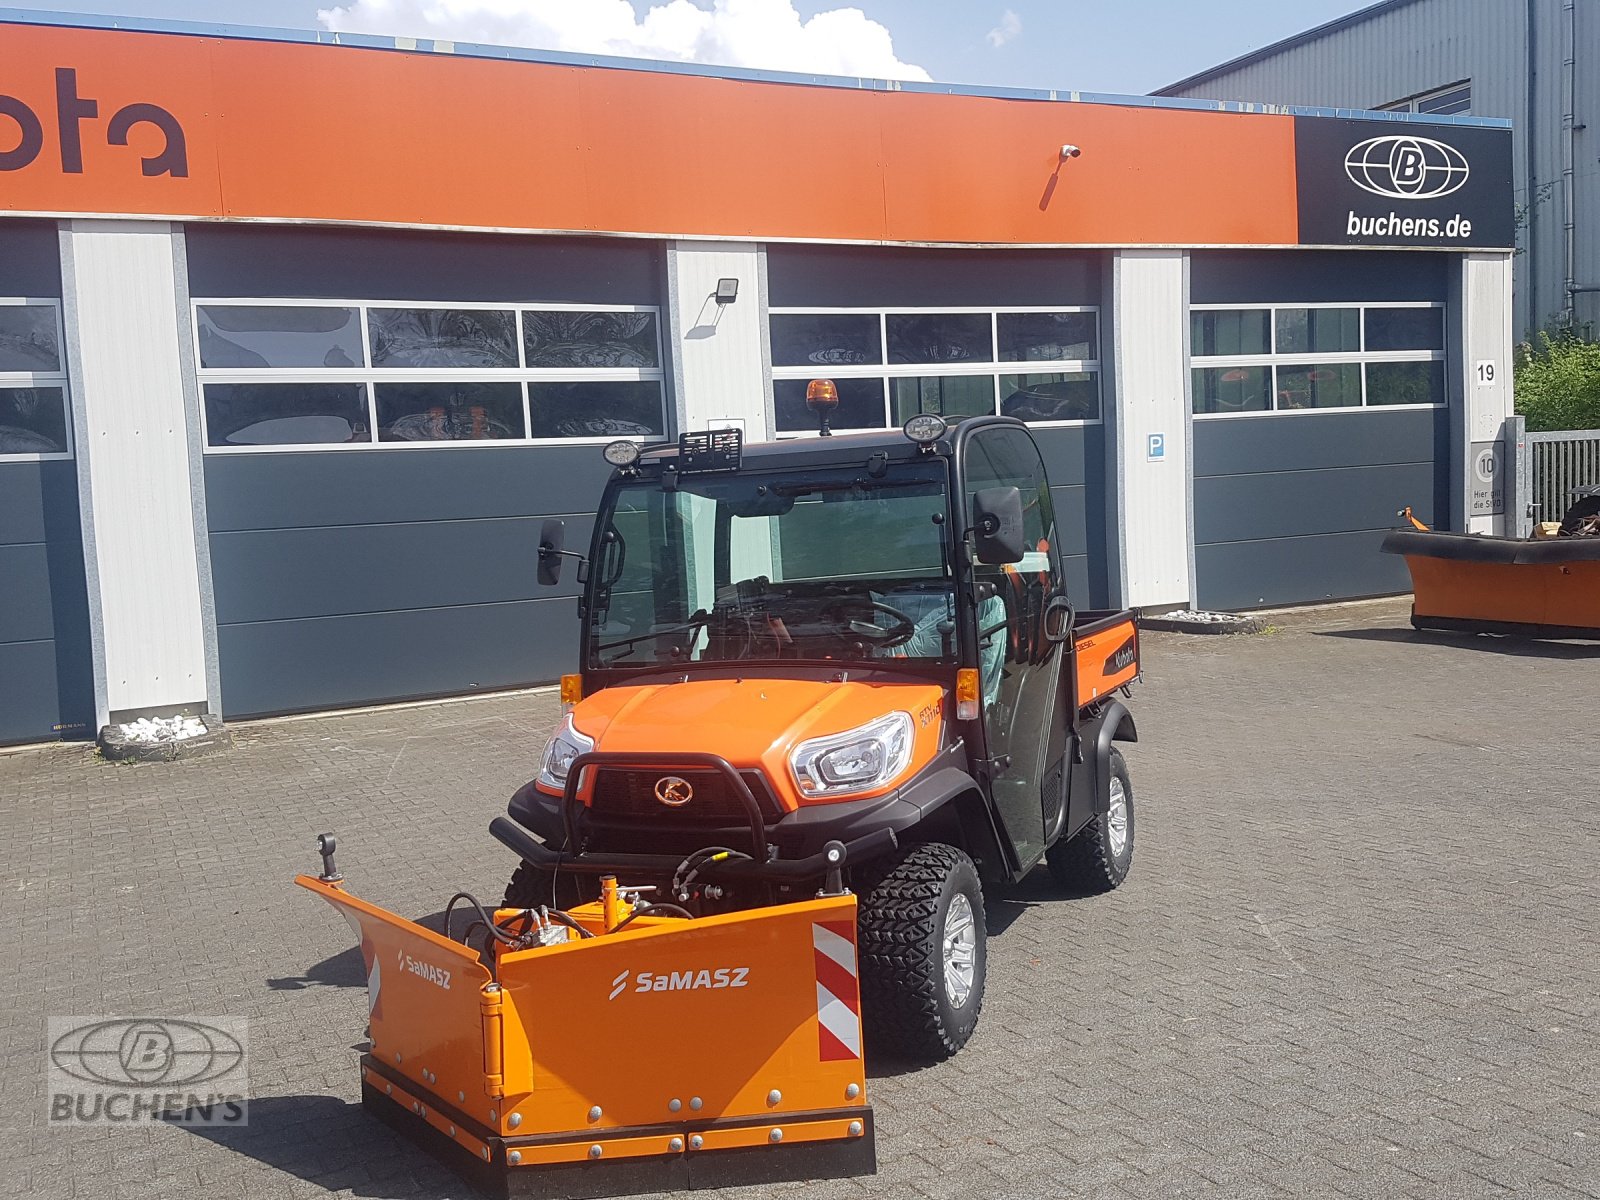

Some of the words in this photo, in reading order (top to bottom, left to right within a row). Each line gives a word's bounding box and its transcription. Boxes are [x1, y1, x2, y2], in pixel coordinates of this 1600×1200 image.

[1346, 211, 1472, 238] buchens.de
[1477, 364, 1495, 381] 19
[1150, 436, 1162, 455] P
[1481, 458, 1494, 473] 10
[1474, 490, 1488, 499] Hier
[1474, 501, 1484, 509] die
[1076, 640, 1096, 652] DIESEL
[1115, 647, 1134, 669] Kubota
[405, 955, 452, 990] SaMASZ
[635, 967, 751, 994] SaMASZ
